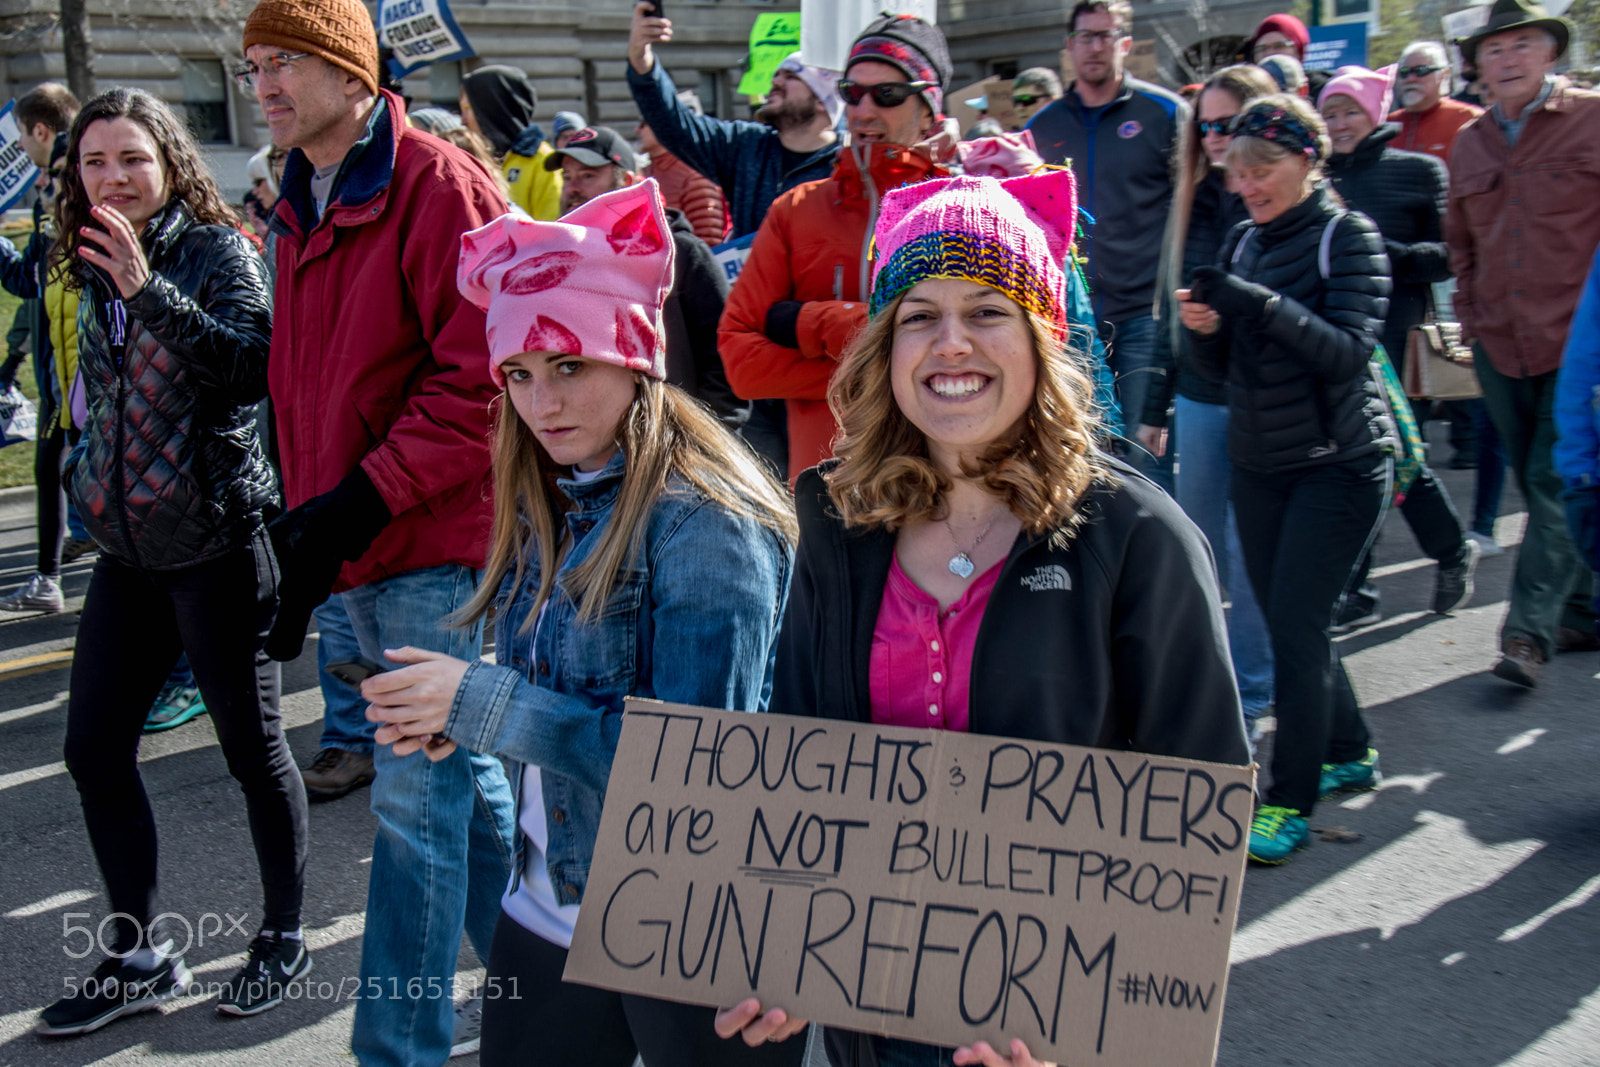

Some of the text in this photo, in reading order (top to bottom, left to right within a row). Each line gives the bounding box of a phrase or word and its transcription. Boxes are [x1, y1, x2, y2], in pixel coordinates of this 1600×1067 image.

[384, 0, 425, 25] MARCH
[386, 14, 441, 44] FOR OUR
[396, 38, 435, 57] LIVES
[1020, 573, 1054, 586] NORTH
[1034, 564, 1054, 575] THE
[1030, 579, 1054, 592] FACE
[627, 711, 933, 805] THOUGHTS
[981, 743, 1253, 855] PRAYERS
[625, 802, 1228, 924] are NOT BULLETPROOF!
[601, 868, 1216, 1055] GUN REFORM #NOW
